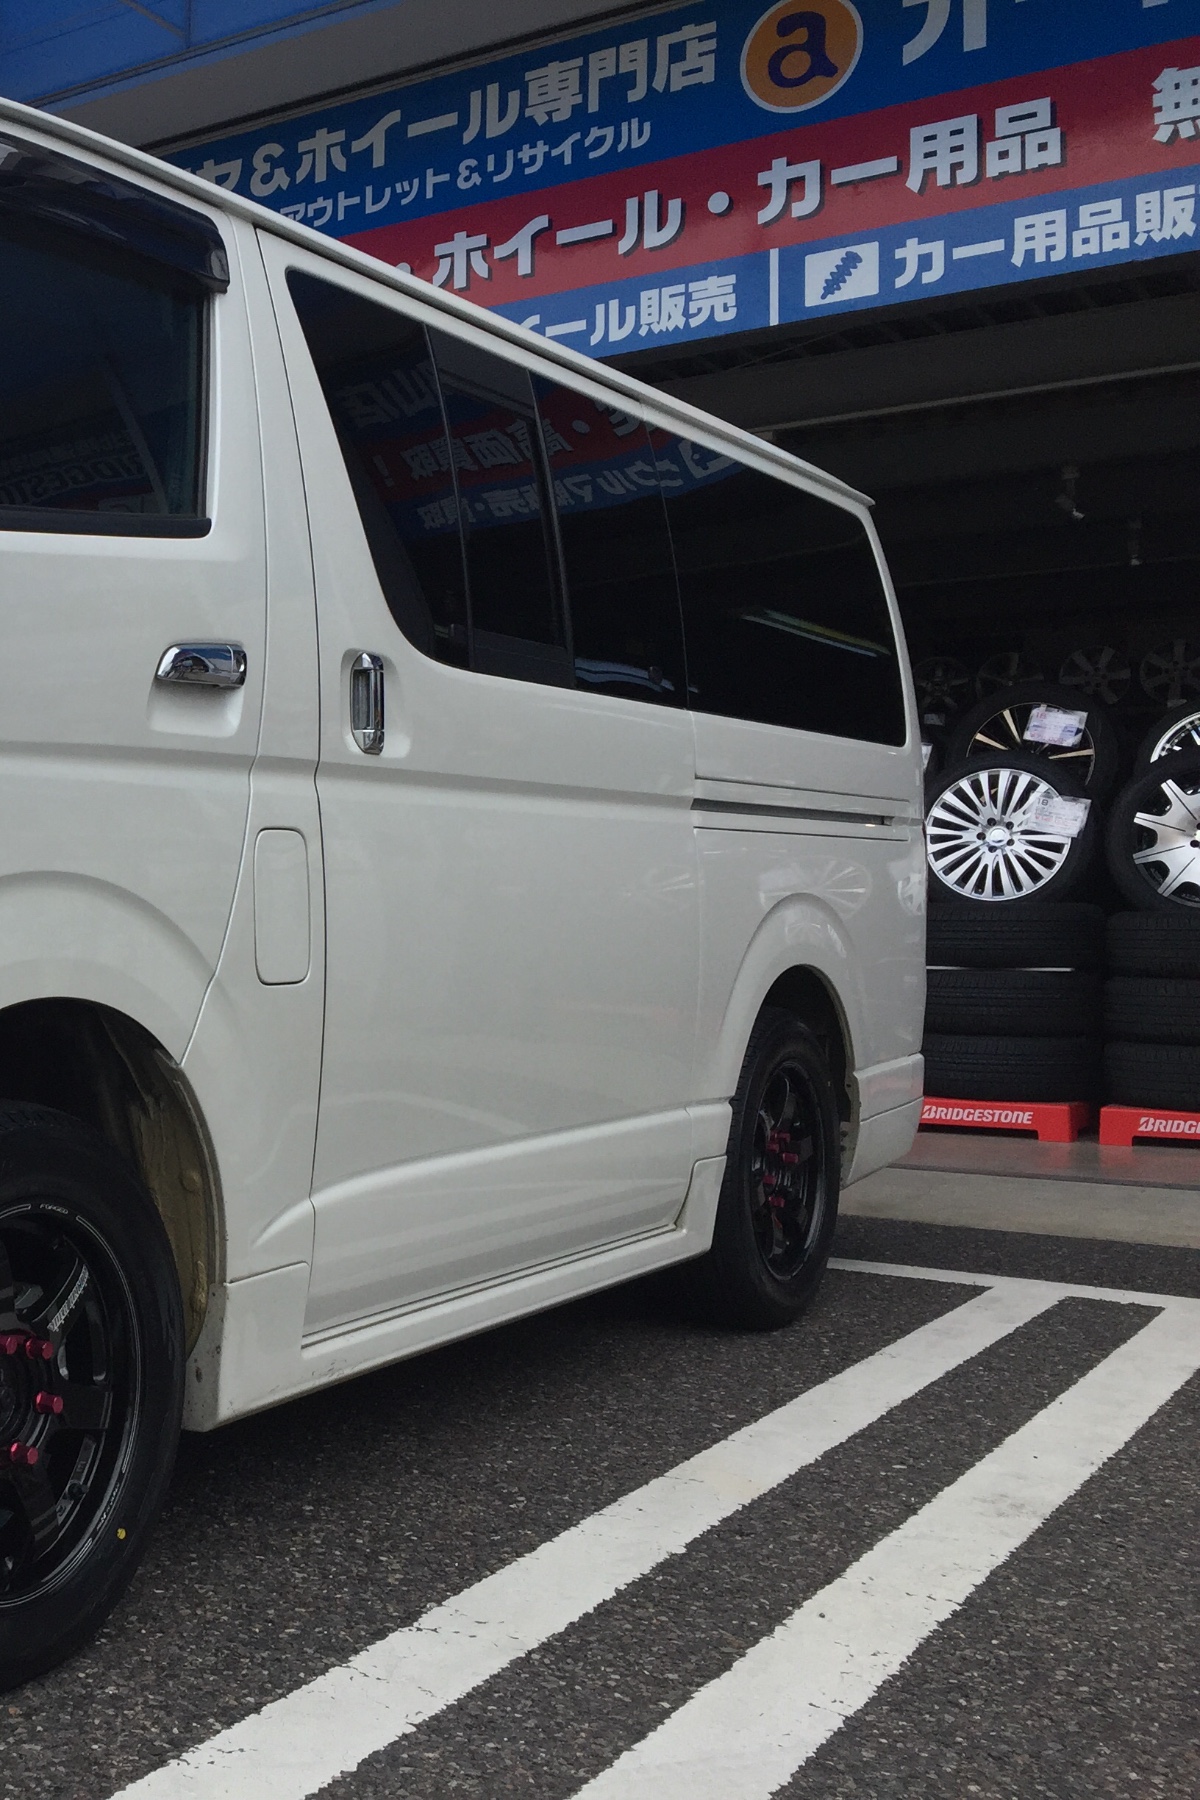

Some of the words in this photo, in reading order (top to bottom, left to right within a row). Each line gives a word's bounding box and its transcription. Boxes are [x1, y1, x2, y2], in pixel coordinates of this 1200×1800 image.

[185, 20, 717, 197] ヤ&ホイール専門店
[894, 184, 1200, 289] カー用品販
[922, 1105, 1033, 1124] BRIDGESTONE
